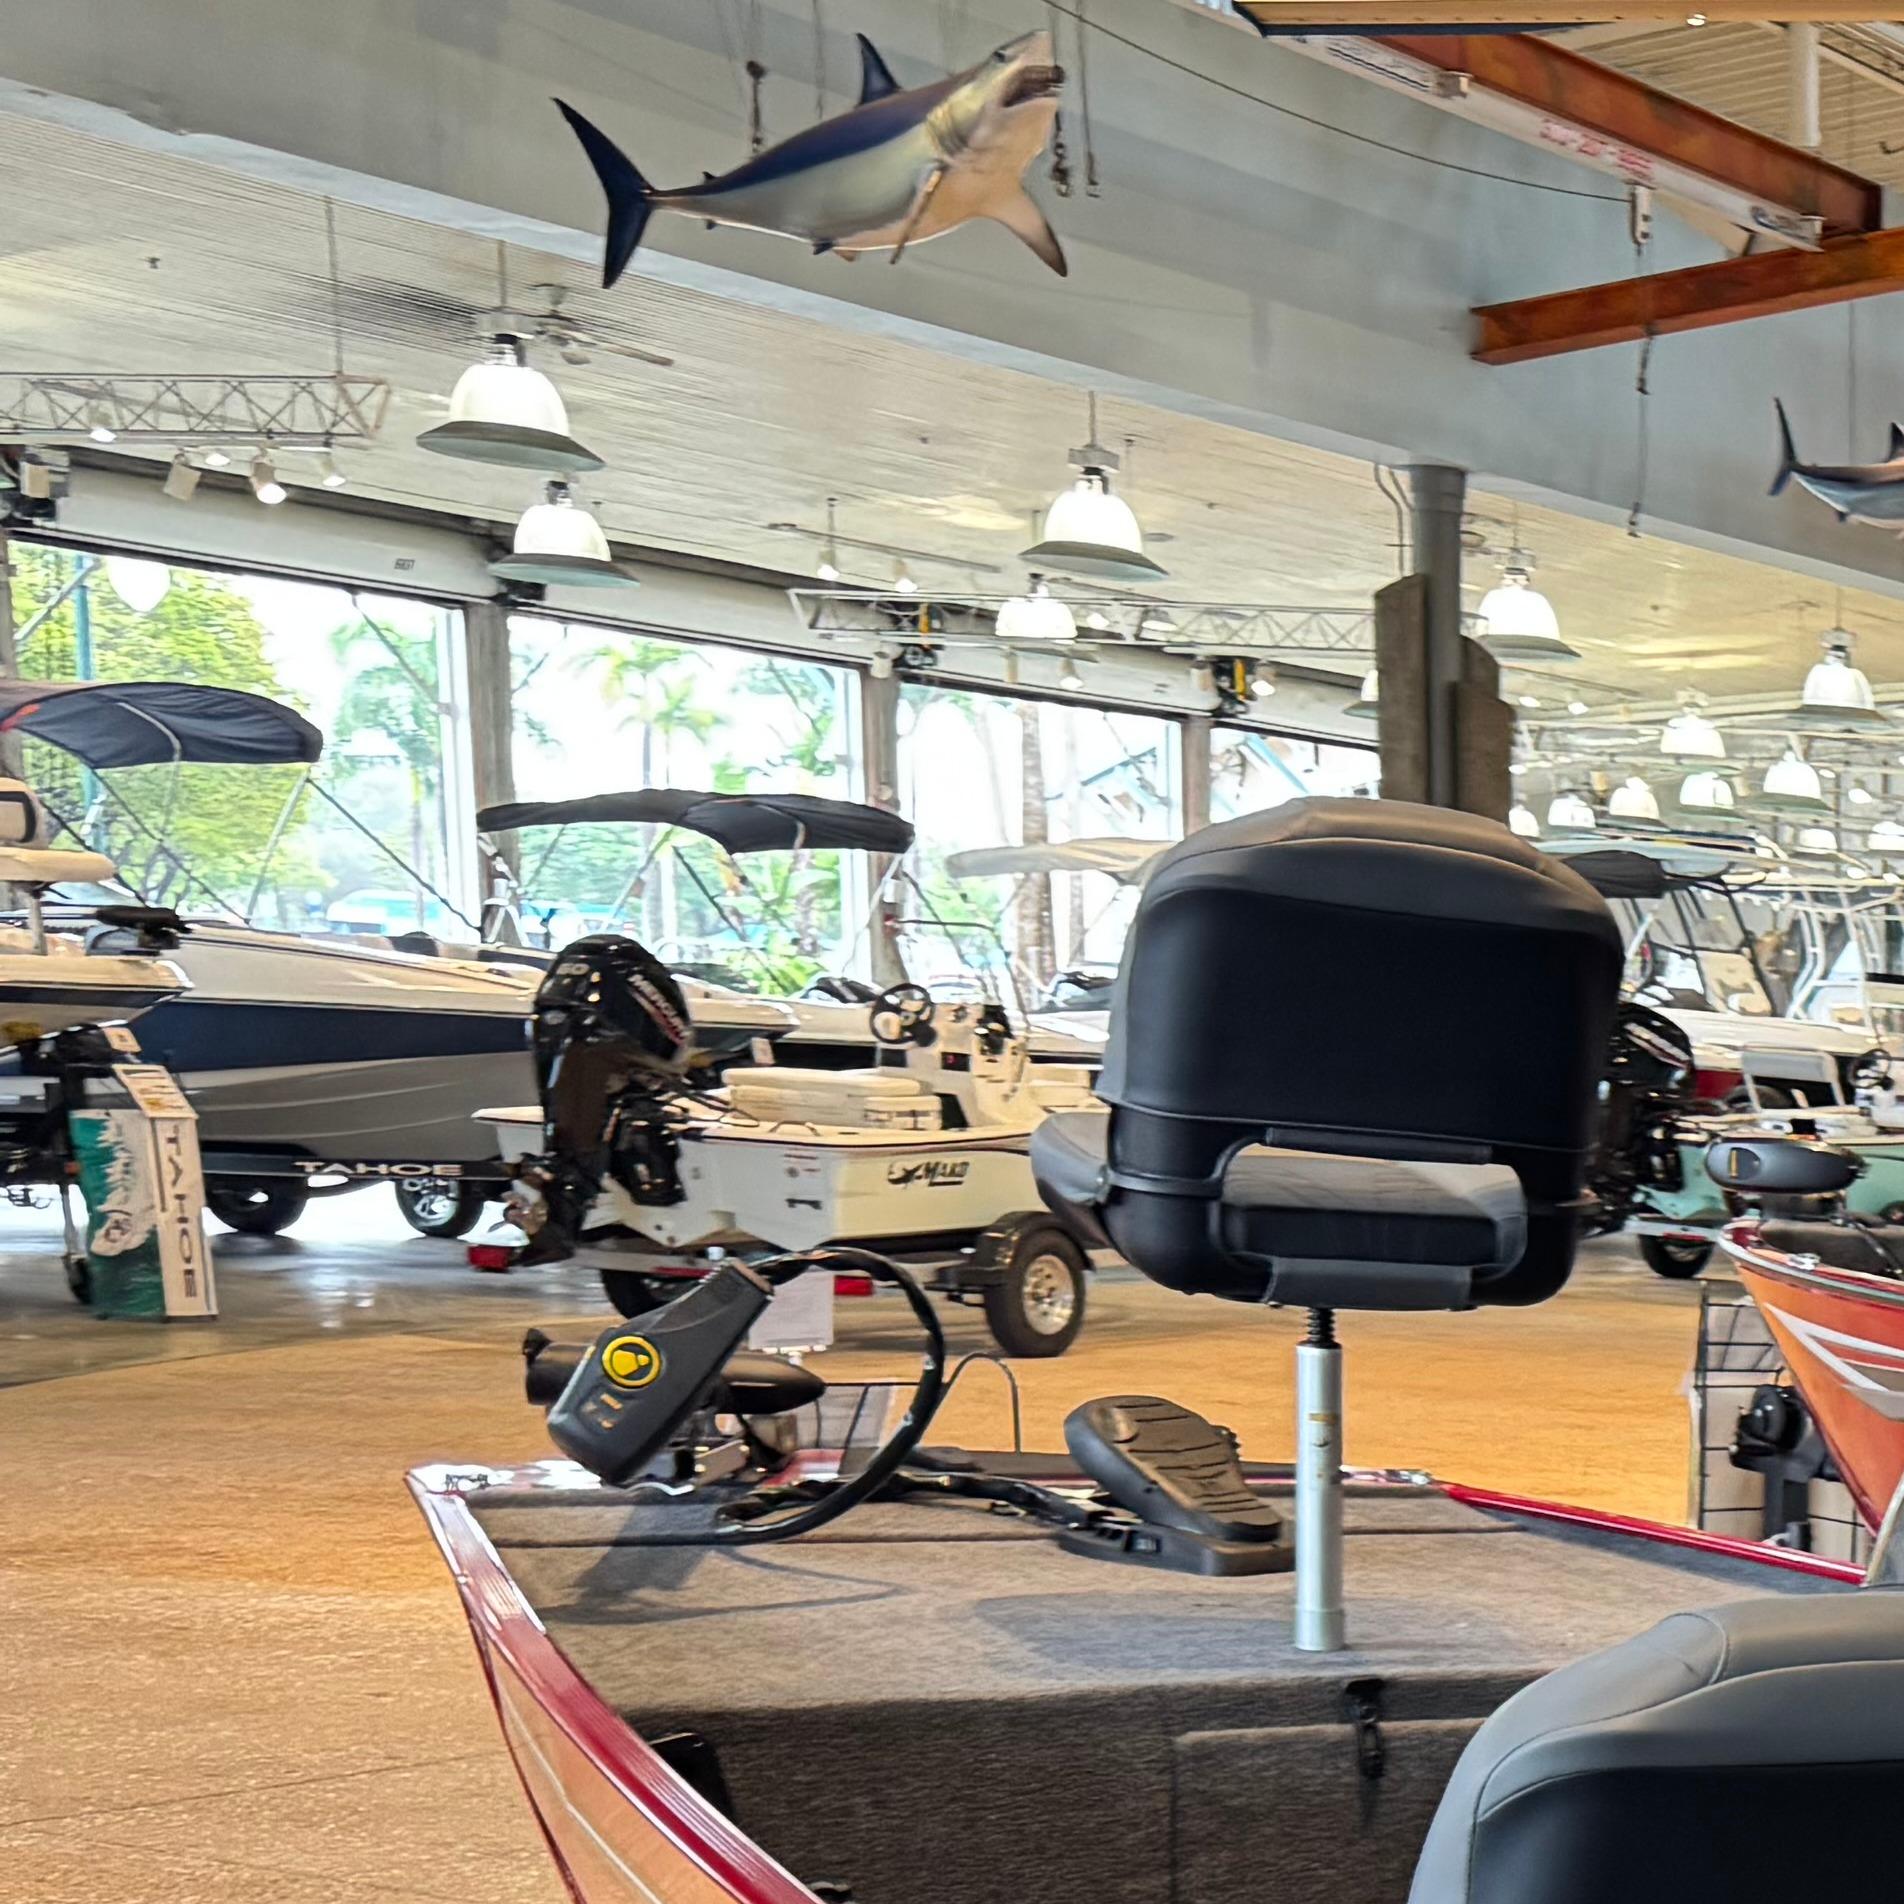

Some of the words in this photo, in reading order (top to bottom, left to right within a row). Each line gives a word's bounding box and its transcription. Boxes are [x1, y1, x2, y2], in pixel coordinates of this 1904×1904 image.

[293, 1161, 463, 1177] TAHOE
[920, 1160, 971, 1187] MAKO
[165, 1123, 197, 1298] TAHOE
